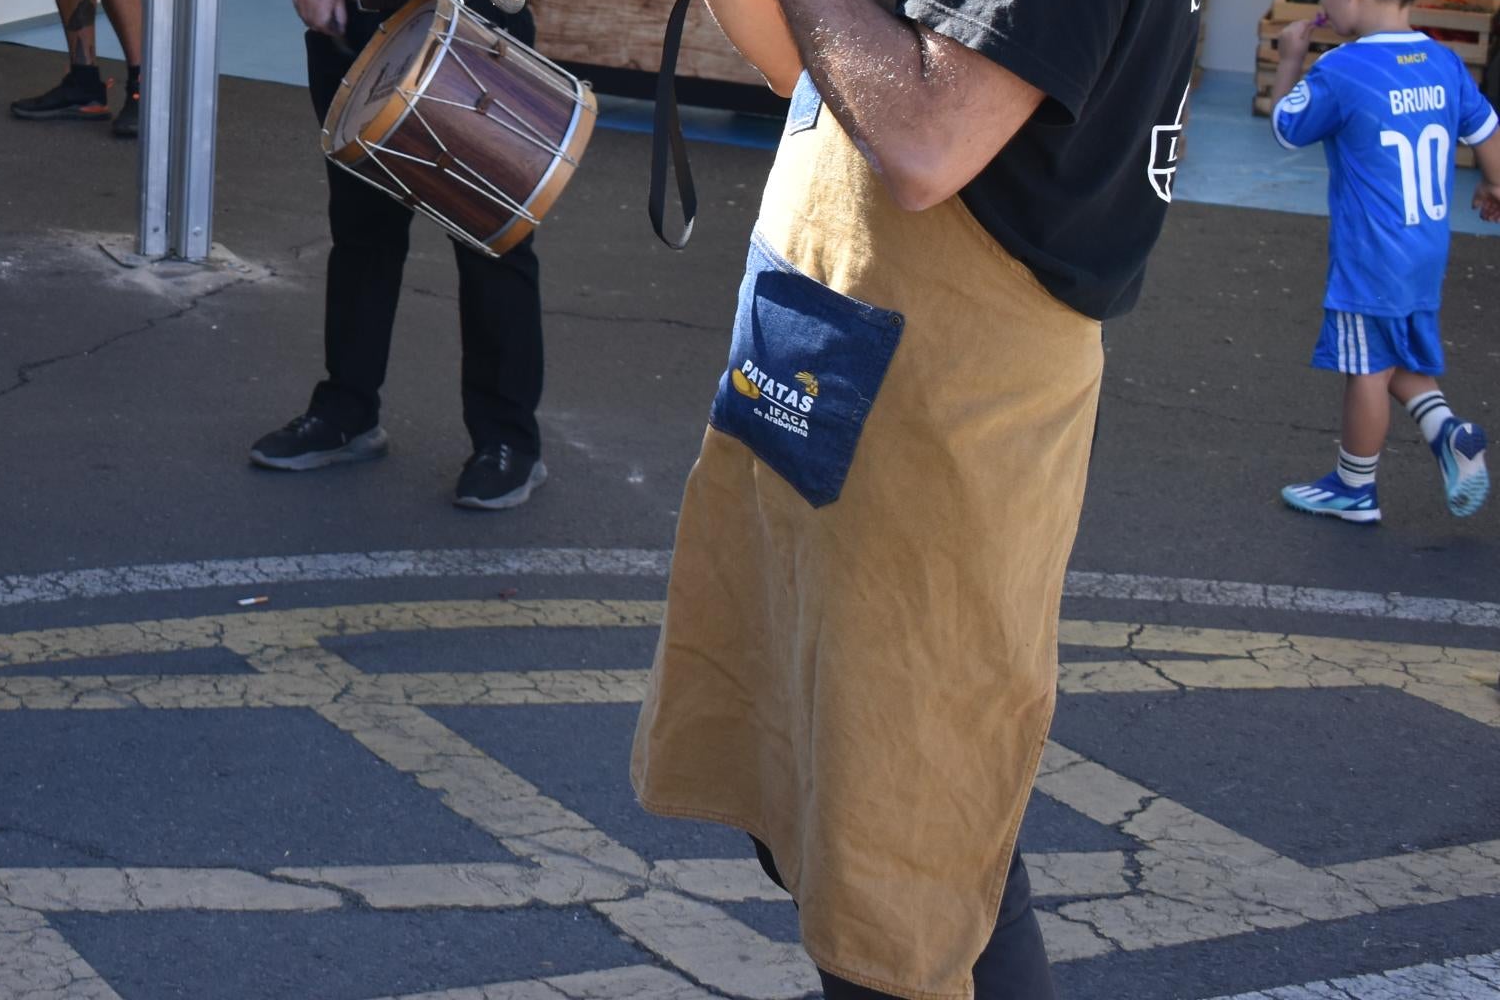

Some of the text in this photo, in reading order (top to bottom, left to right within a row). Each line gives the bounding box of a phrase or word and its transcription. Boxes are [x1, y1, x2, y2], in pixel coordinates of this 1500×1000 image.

[1389, 85, 1446, 116] BRUNO
[1380, 123, 1450, 227] 10
[741, 359, 814, 413] PATATAS
